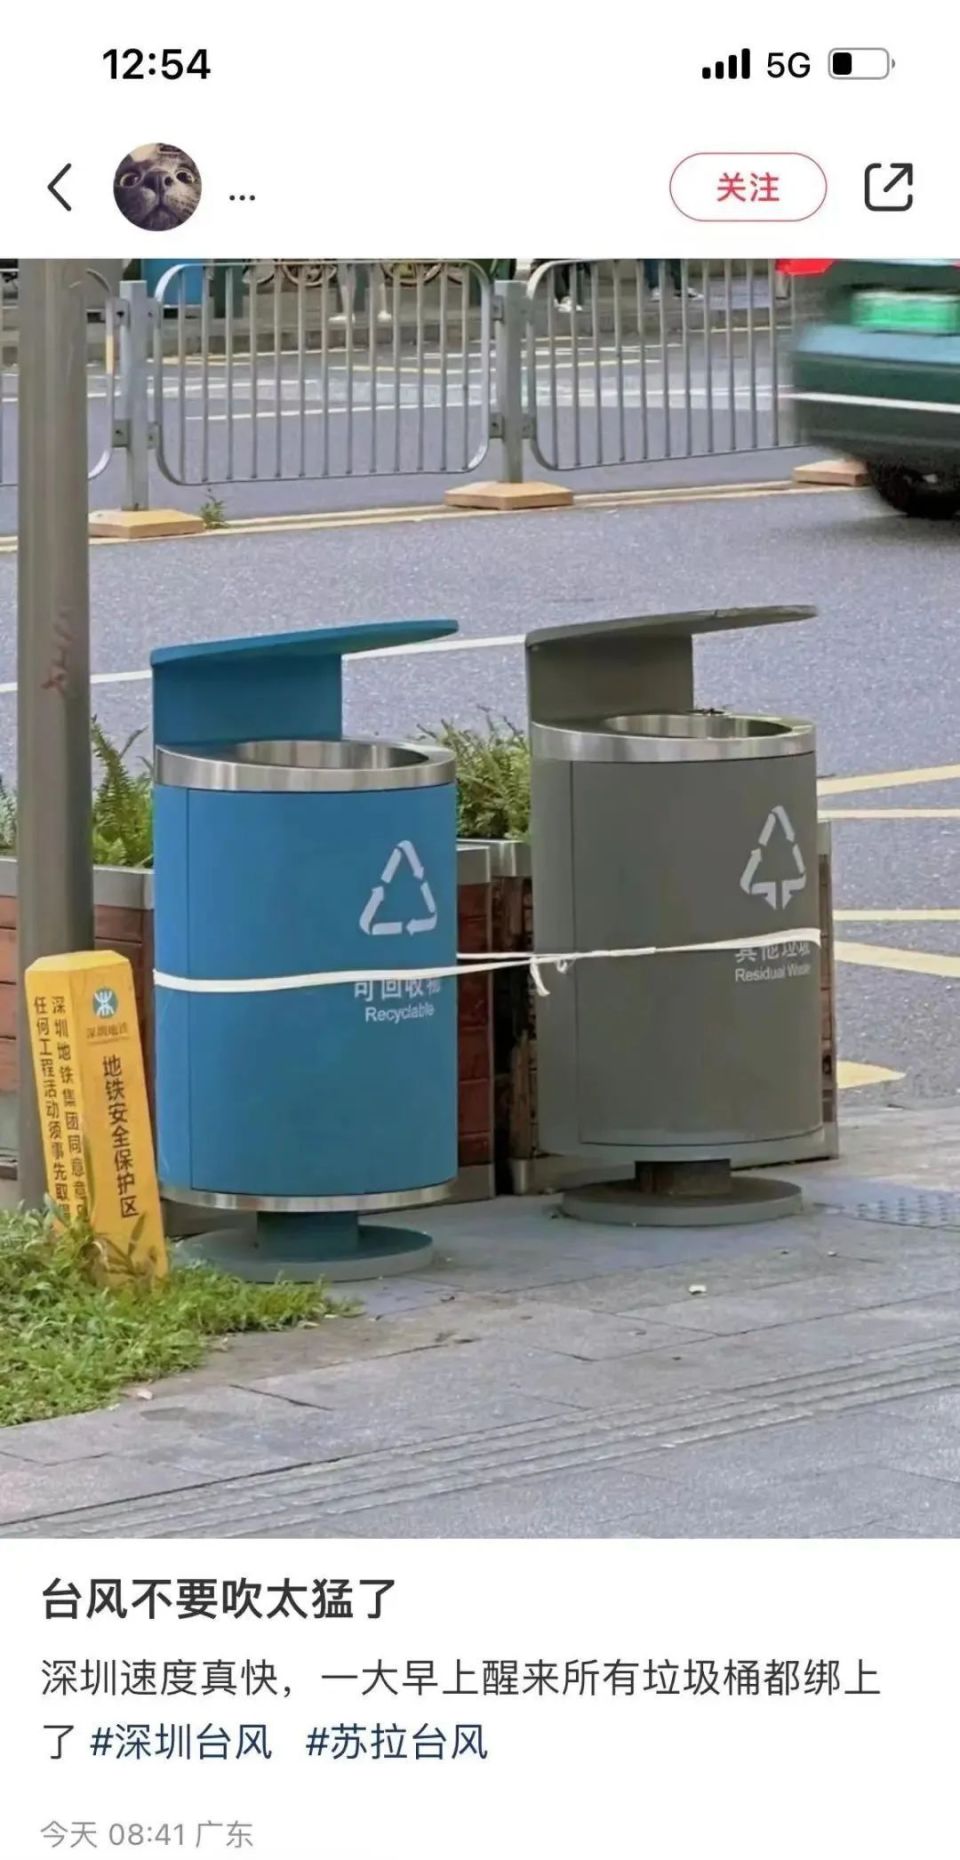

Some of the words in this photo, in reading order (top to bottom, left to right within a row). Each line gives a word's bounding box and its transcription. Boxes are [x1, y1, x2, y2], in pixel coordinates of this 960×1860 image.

[734, 966, 786, 982] Residual
[365, 1002, 436, 1024] Recyclable
[102, 1054, 139, 1219] 地铁安全保护区
